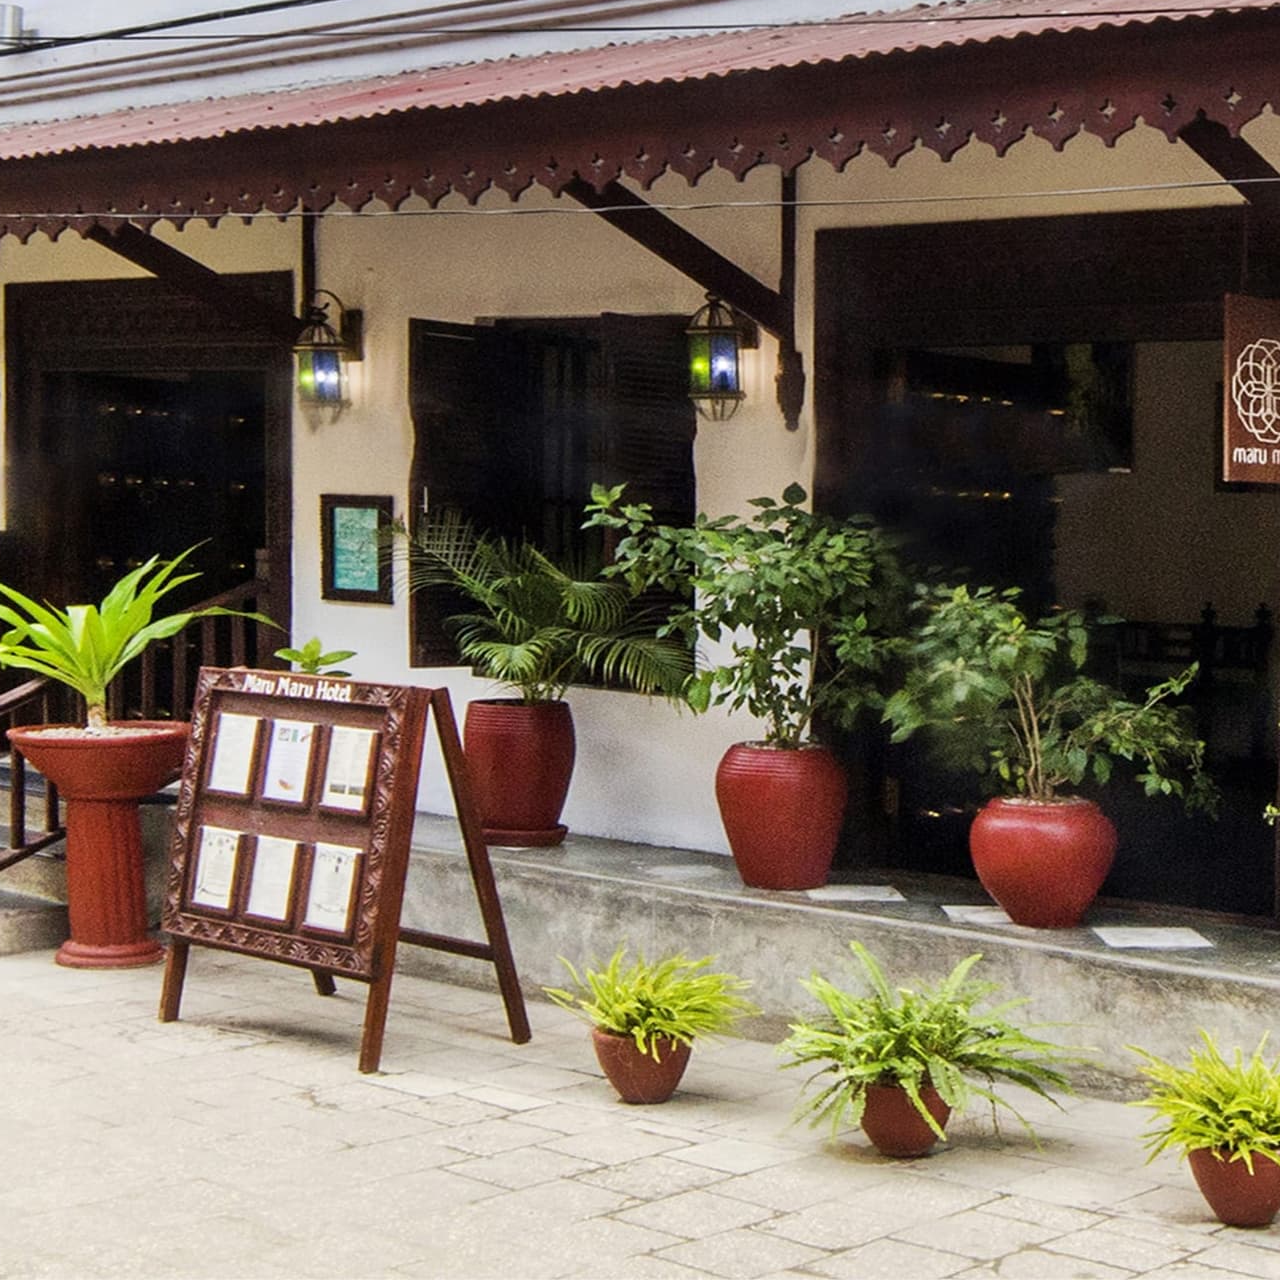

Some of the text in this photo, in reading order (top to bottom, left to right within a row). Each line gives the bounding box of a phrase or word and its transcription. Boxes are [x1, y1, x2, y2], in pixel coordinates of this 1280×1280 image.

[1234, 448, 1267, 464] maru
[242, 674, 352, 702] Maru Maru Hotel
